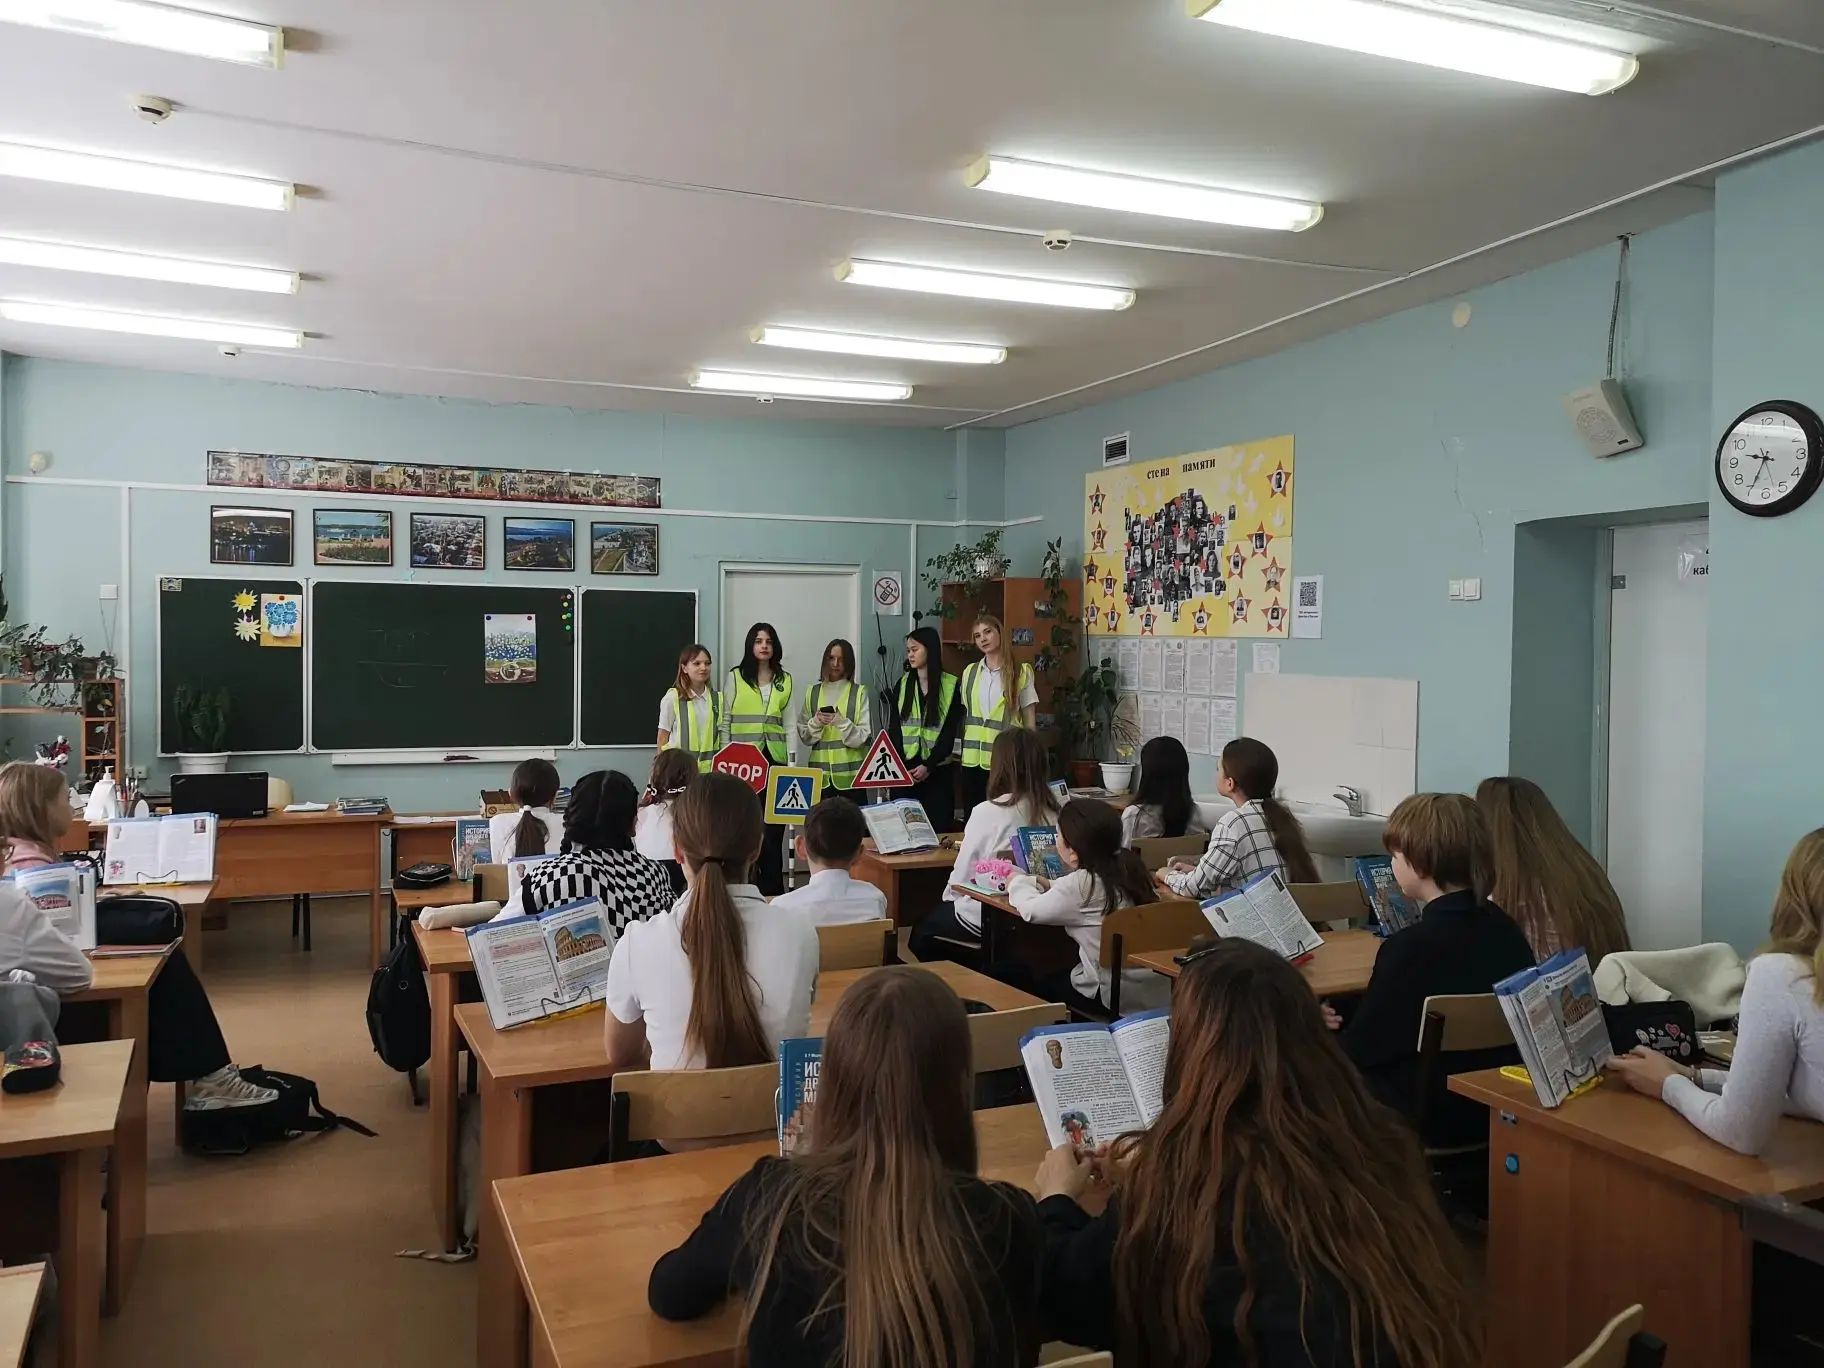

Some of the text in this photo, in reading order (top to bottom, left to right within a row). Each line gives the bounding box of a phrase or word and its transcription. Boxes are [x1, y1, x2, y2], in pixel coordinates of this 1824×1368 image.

[1761, 417, 1774, 428] 12
[1734, 438, 1747, 451] 10
[1795, 448, 1807, 460] 3
[1729, 457, 1739, 469] 9
[1147, 459, 1216, 480] стена памяти
[1790, 466, 1801, 478] 4
[1734, 473, 1744, 485] 8
[1746, 484, 1755, 497] 7
[1761, 487, 1771, 499] 6
[1777, 481, 1788, 493] 5
[717, 761, 763, 782] STOP
[804, 1061, 821, 1077] ИС
[803, 1078, 819, 1091] ДР
